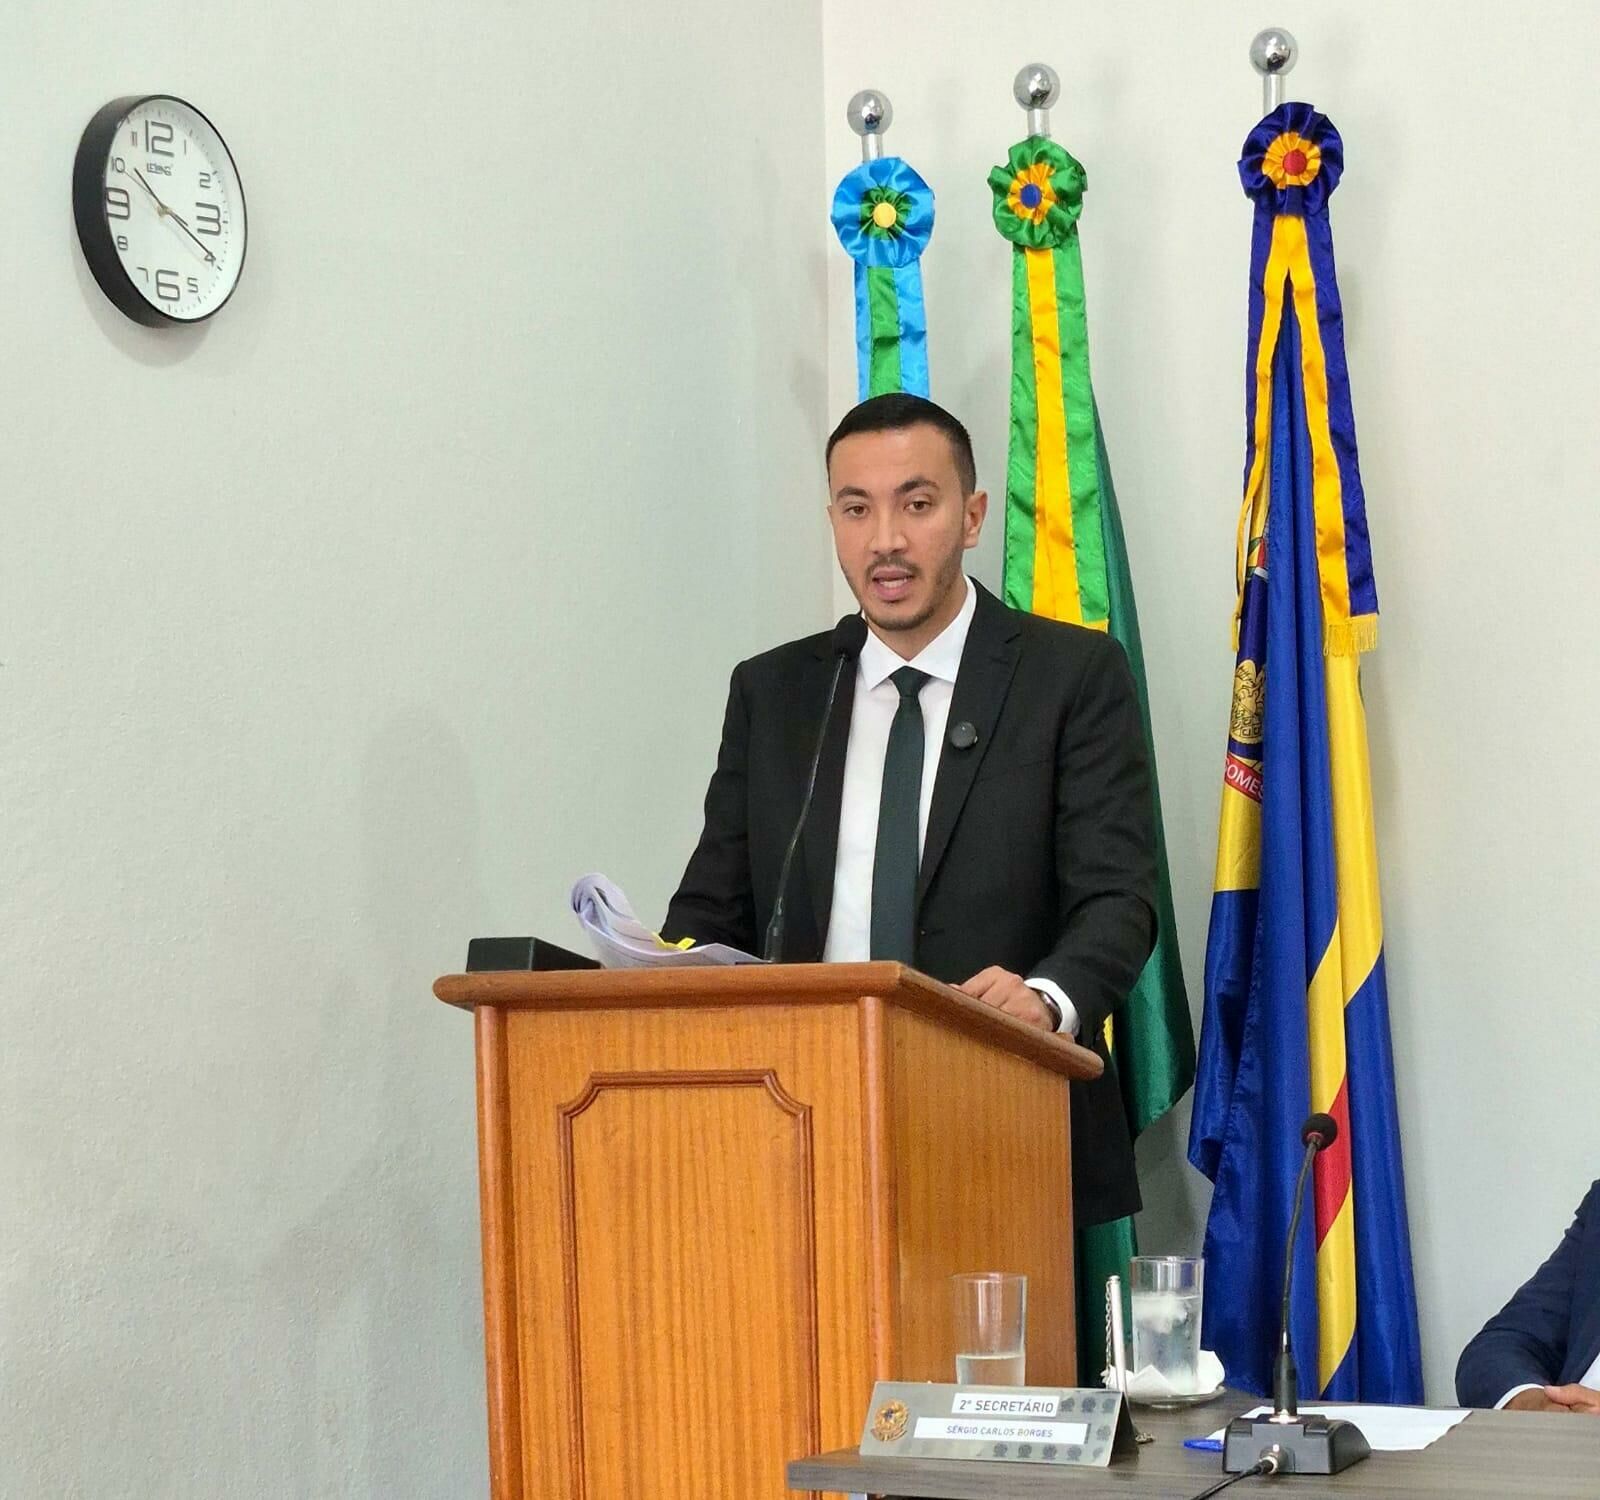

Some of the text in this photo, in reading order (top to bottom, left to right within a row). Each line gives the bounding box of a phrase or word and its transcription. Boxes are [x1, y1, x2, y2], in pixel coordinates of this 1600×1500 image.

[145, 120, 174, 157] 12
[111, 156, 125, 173] 10
[199, 172, 211, 189] 2
[105, 187, 130, 220] 9
[195, 202, 221, 236] 3
[117, 235, 128, 251] 8
[204, 251, 217, 267] 4
[136, 266, 149, 284] 7
[156, 268, 180, 302] 6
[187, 277, 199, 293] 5
[975, 1398, 1054, 1413] SECRETÁRIO
[980, 1426, 1015, 1437] CARLOS
[1017, 1427, 1054, 1438] BORGES
